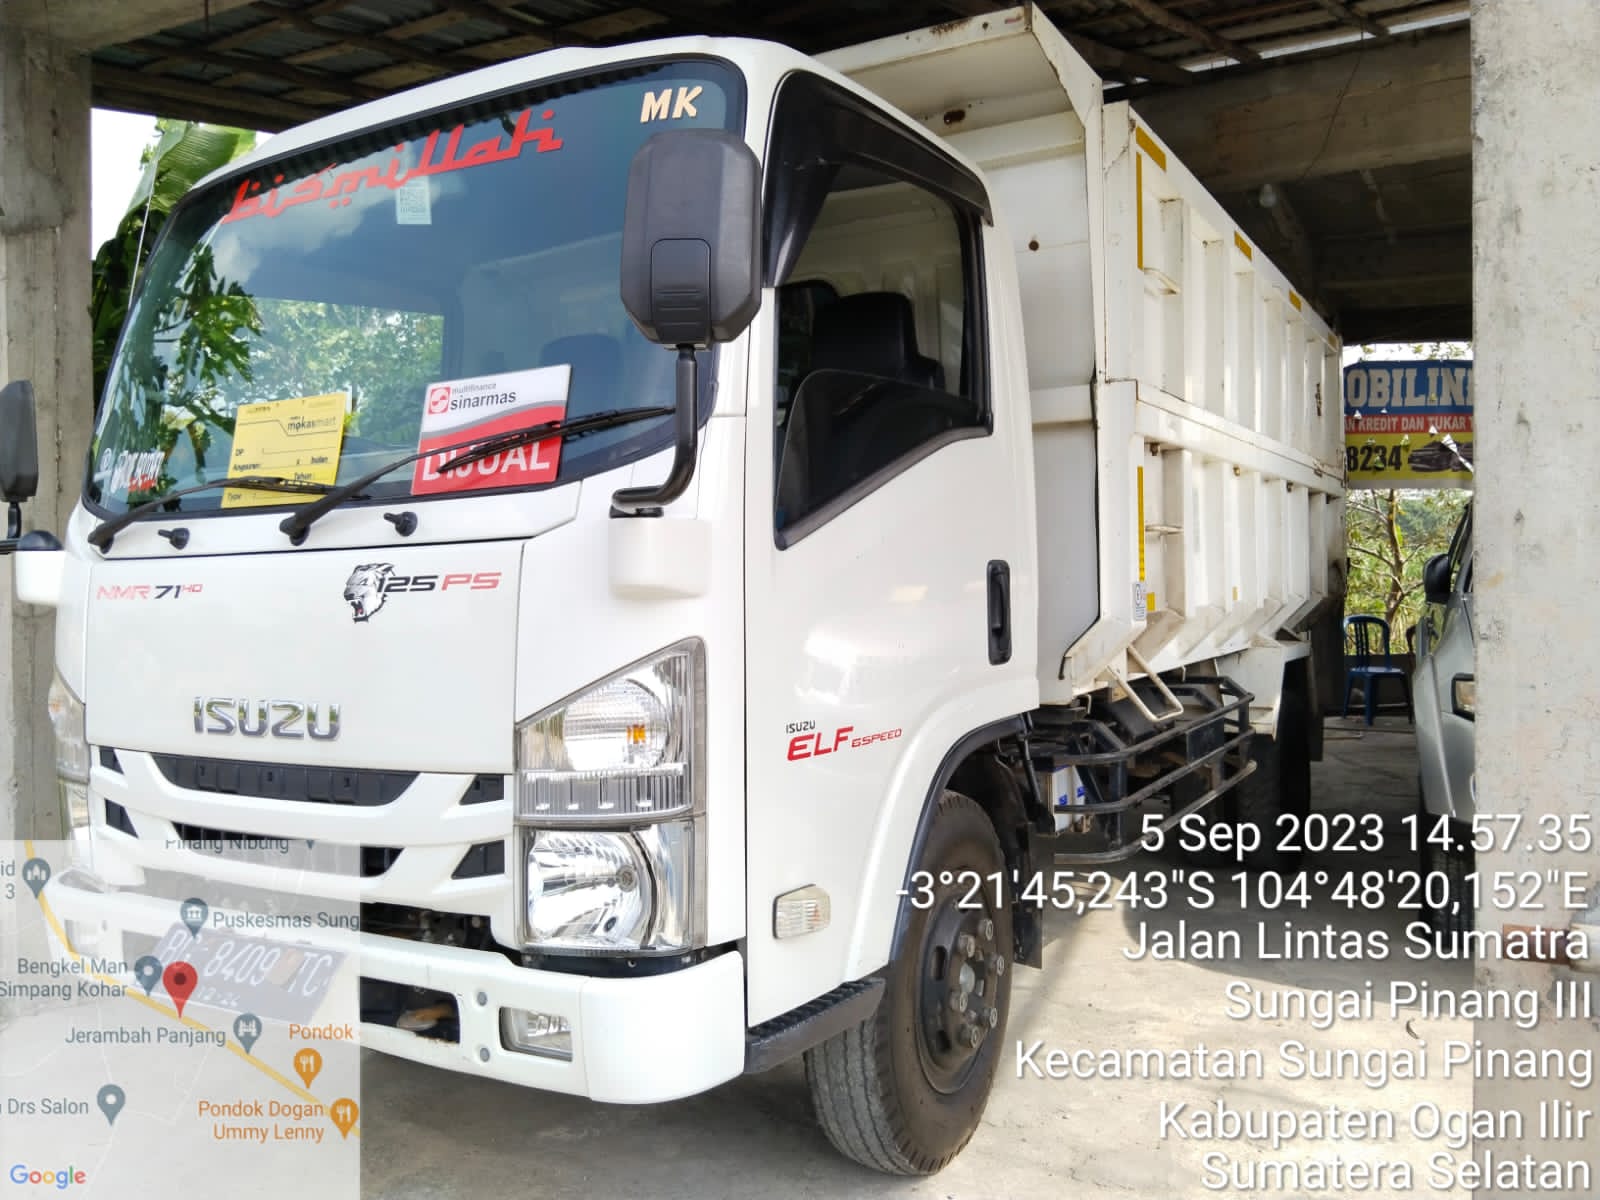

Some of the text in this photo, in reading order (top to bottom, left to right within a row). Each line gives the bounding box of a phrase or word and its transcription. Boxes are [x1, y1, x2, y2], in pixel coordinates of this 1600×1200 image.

[640, 85, 703, 124] MK
[450, 391, 516, 411] sinarmas
[1346, 368, 1473, 408] OBILIN
[1358, 415, 1399, 431] KREDIT
[1401, 415, 1424, 430] DAN
[1428, 414, 1466, 431] TUKAR
[97, 585, 151, 600] NMR
[377, 572, 502, 592] 125 PS
[193, 695, 342, 742] ISUZU
[785, 719, 816, 734] ISUZU
[787, 726, 854, 761] ELF
[204, 940, 281, 986] 8409
[288, 951, 333, 997] TC
